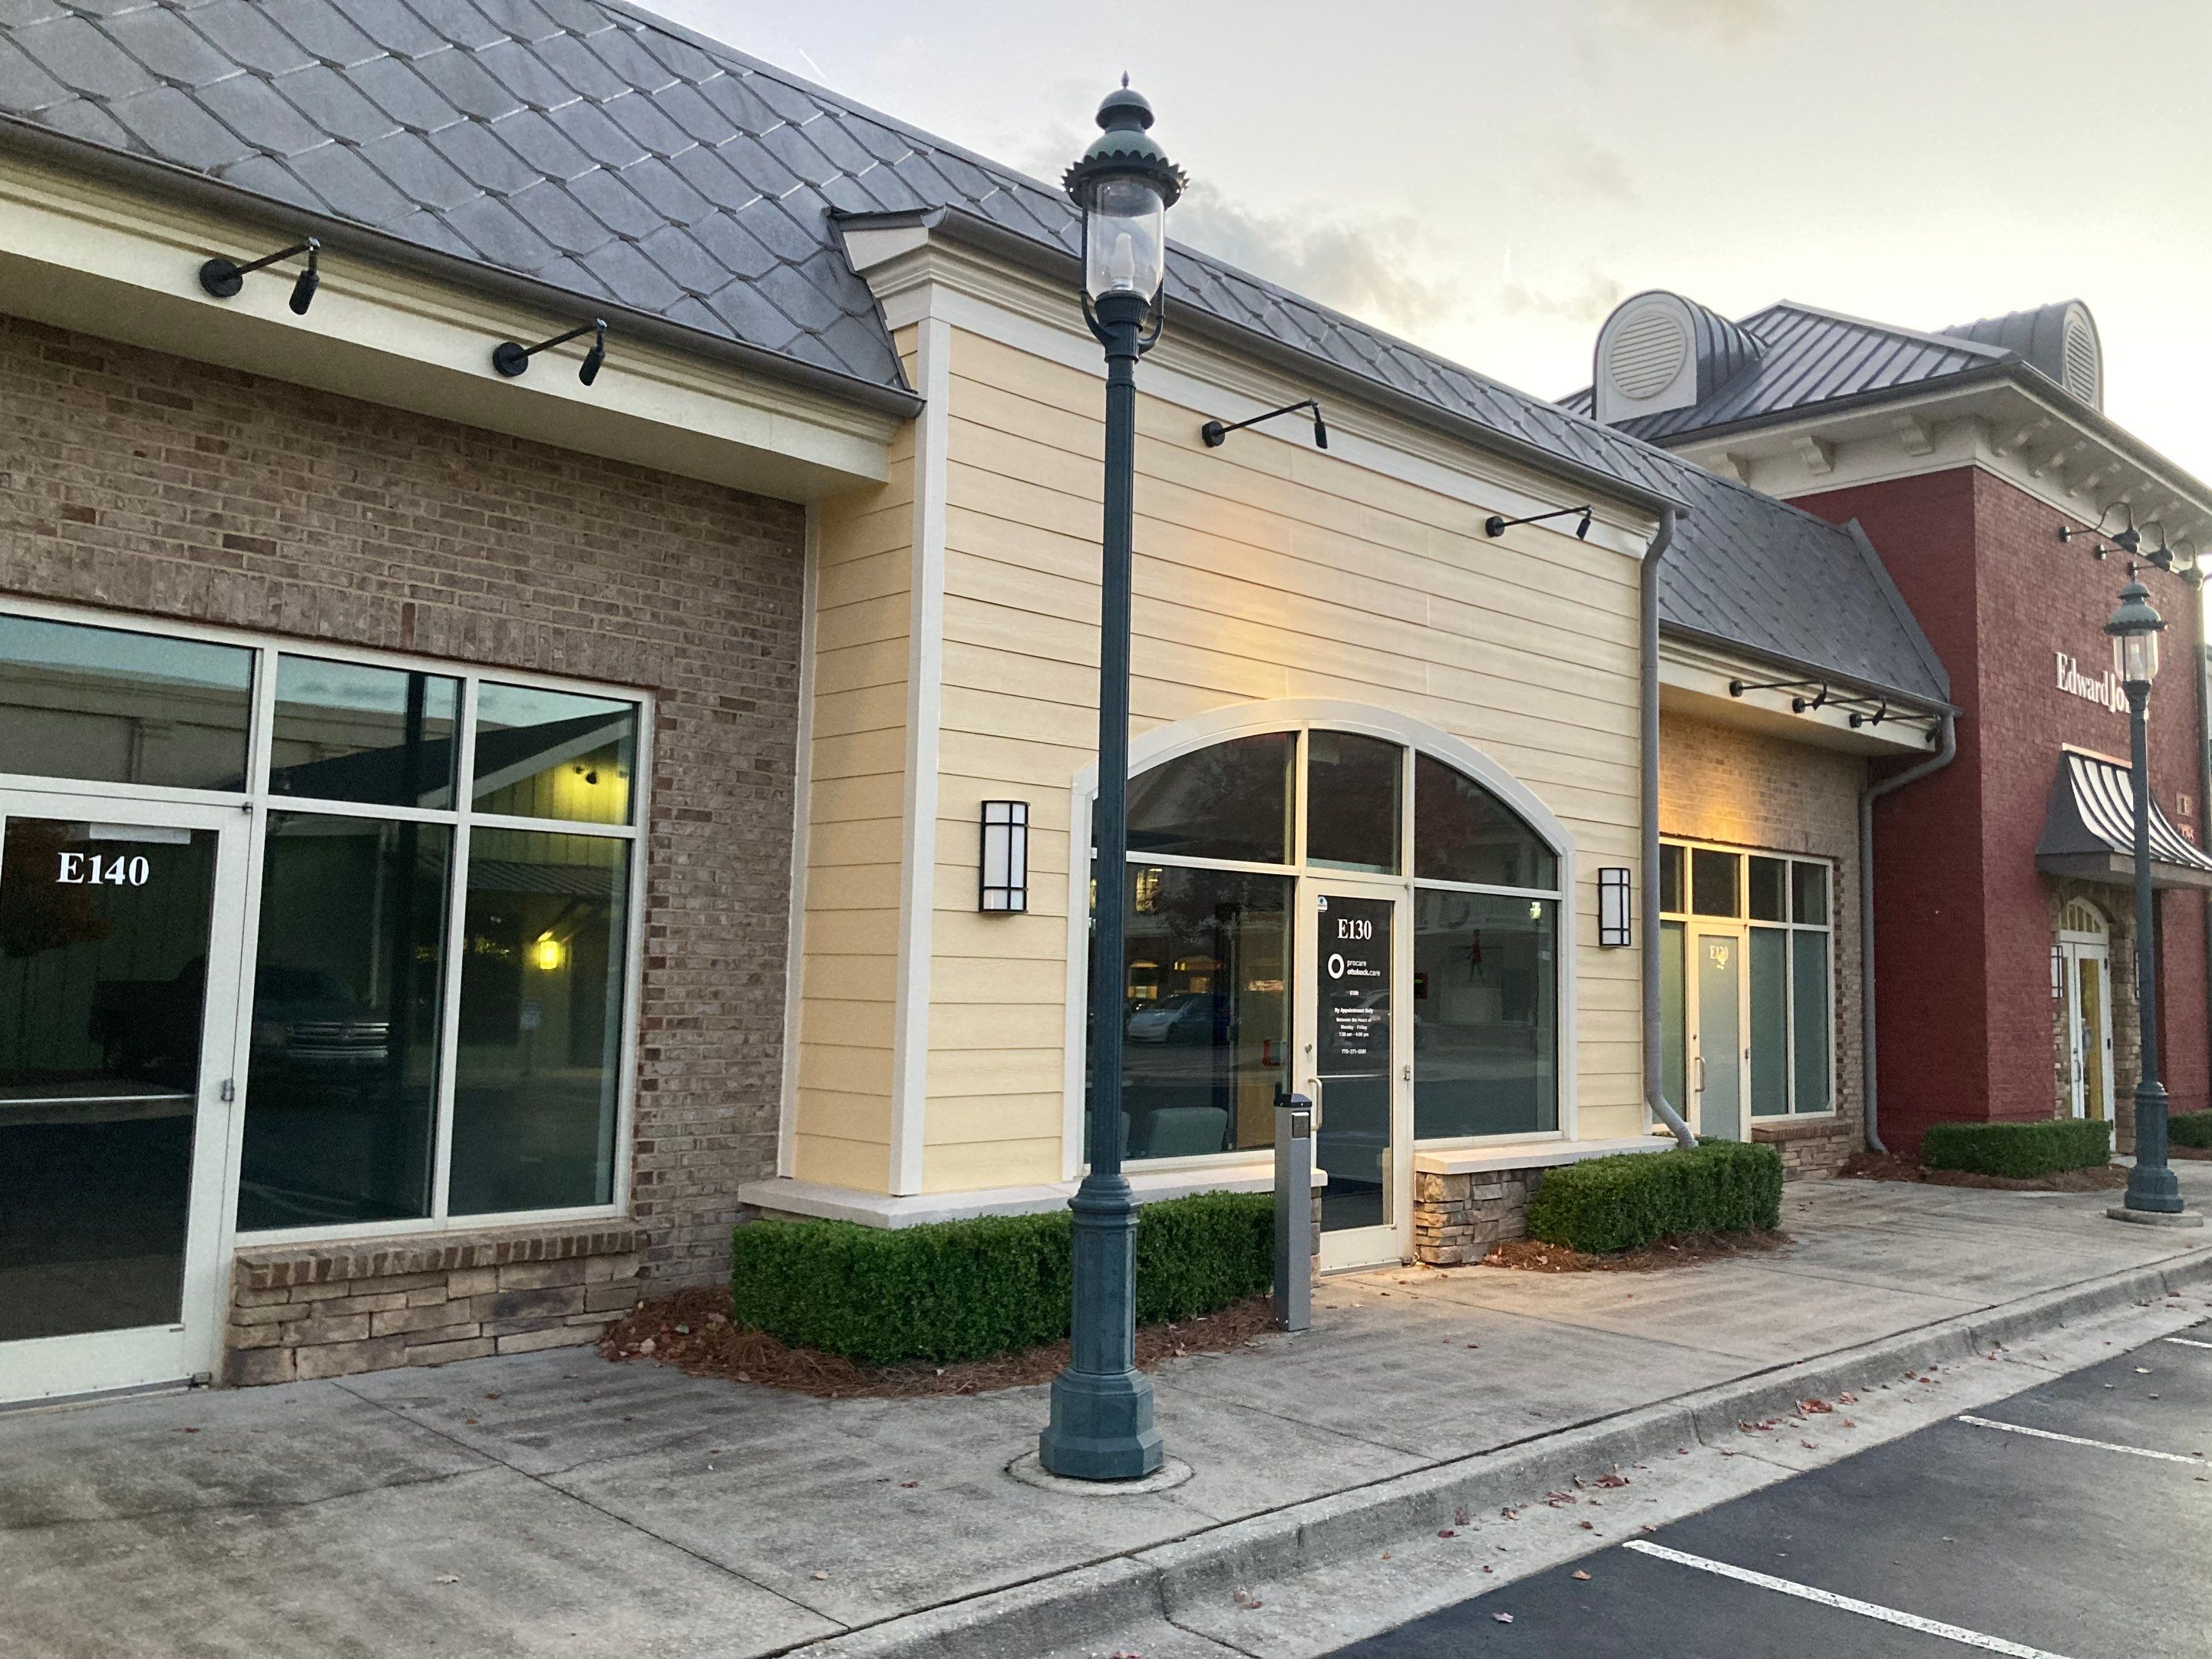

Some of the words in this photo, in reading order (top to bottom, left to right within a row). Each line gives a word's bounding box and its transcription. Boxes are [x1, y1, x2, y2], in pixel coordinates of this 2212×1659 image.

[2055, 651, 2109, 706] Edward
[55, 852, 150, 886] E140
[1337, 919, 1372, 940] E130
[1346, 968, 1381, 977] ottobock.care
